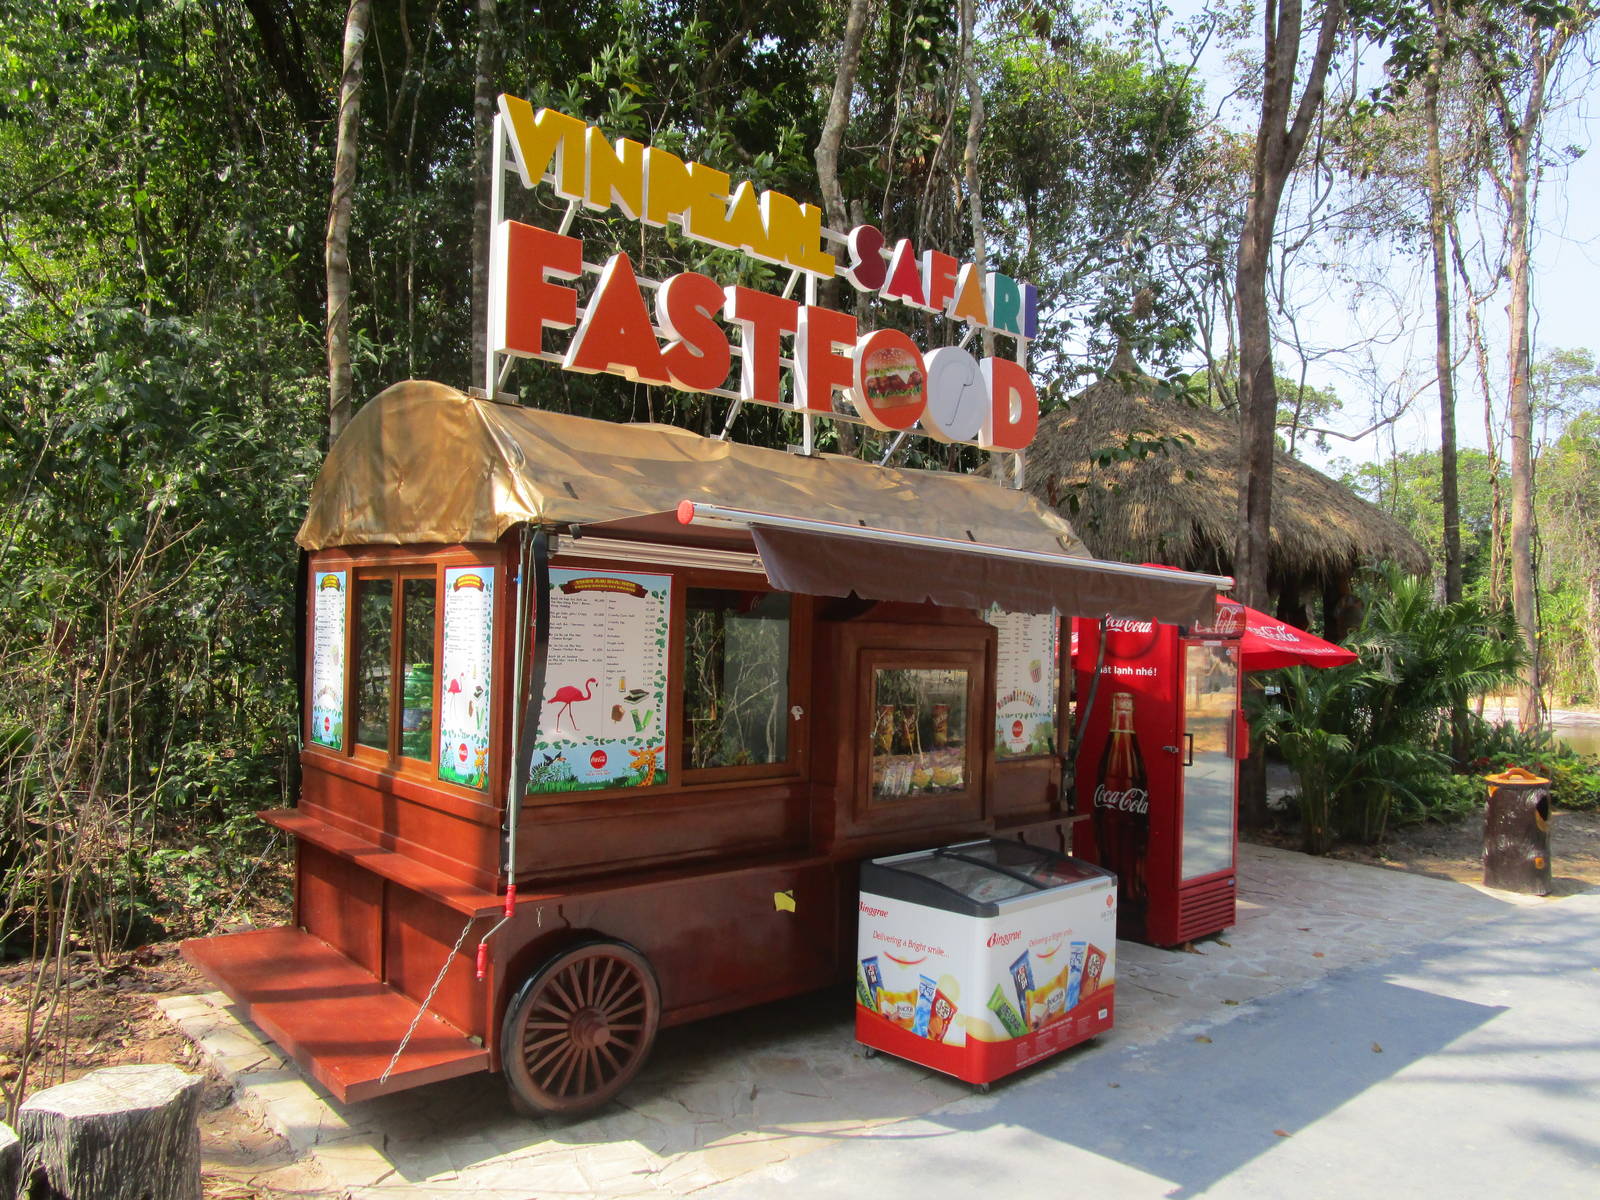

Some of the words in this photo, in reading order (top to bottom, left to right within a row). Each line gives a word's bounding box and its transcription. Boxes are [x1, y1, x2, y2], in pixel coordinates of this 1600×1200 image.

[498, 93, 836, 278] VINPEARL
[848, 225, 1038, 340] SAFARI
[1114, 665, 1133, 676] lạnh
[1135, 667, 1157, 677] nhé!
[1094, 784, 1149, 814] Coca-Cola
[873, 930, 902, 948] Delivering
[907, 940, 927, 953] Bright
[986, 931, 1022, 948] Binggrae
